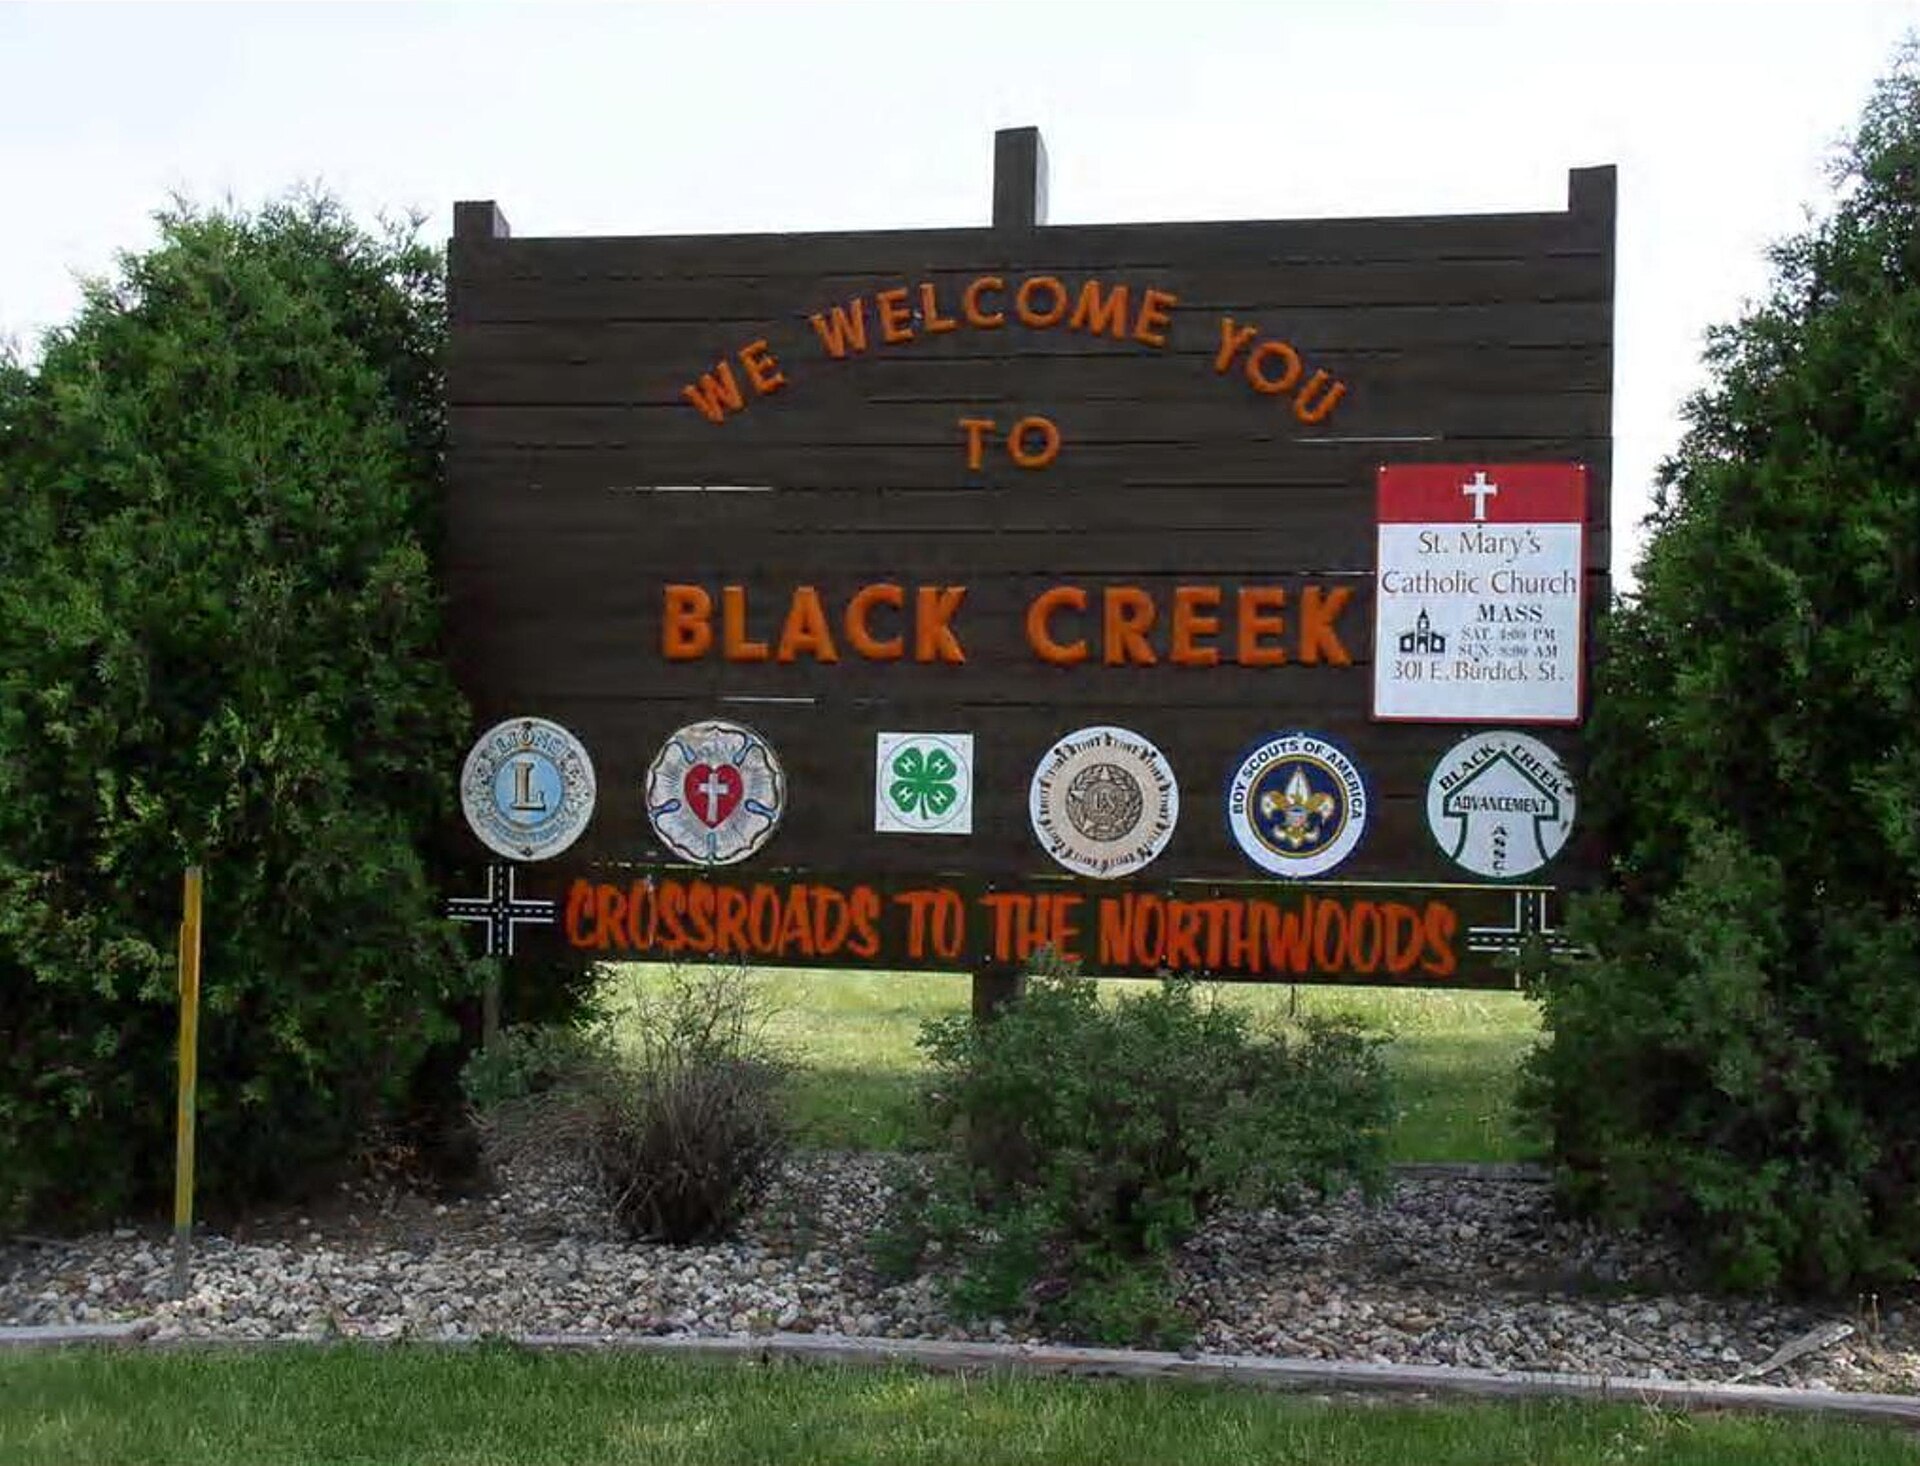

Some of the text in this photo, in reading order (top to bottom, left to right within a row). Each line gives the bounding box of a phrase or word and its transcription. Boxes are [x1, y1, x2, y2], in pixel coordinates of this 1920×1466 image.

[684, 276, 1347, 424] WE WELCOME YOU
[958, 416, 1062, 470] TO
[1419, 530, 1541, 563] St. Mary's
[1382, 570, 1577, 595] Catholic Church
[661, 583, 1354, 666] BLACK CREEK
[1476, 603, 1543, 622] MASS
[1532, 627, 1556, 641] PM
[1455, 660, 1528, 682] Burdick
[510, 761, 546, 811] L
[1233, 739, 1363, 819] BOY SCOUTS OF AMERICA
[1439, 743, 1563, 795] BLACK CREEK
[1454, 796, 1547, 813] ADVANCEMENT
[564, 877, 1458, 977] CROSSROADS TO THE NORTHWOODS
